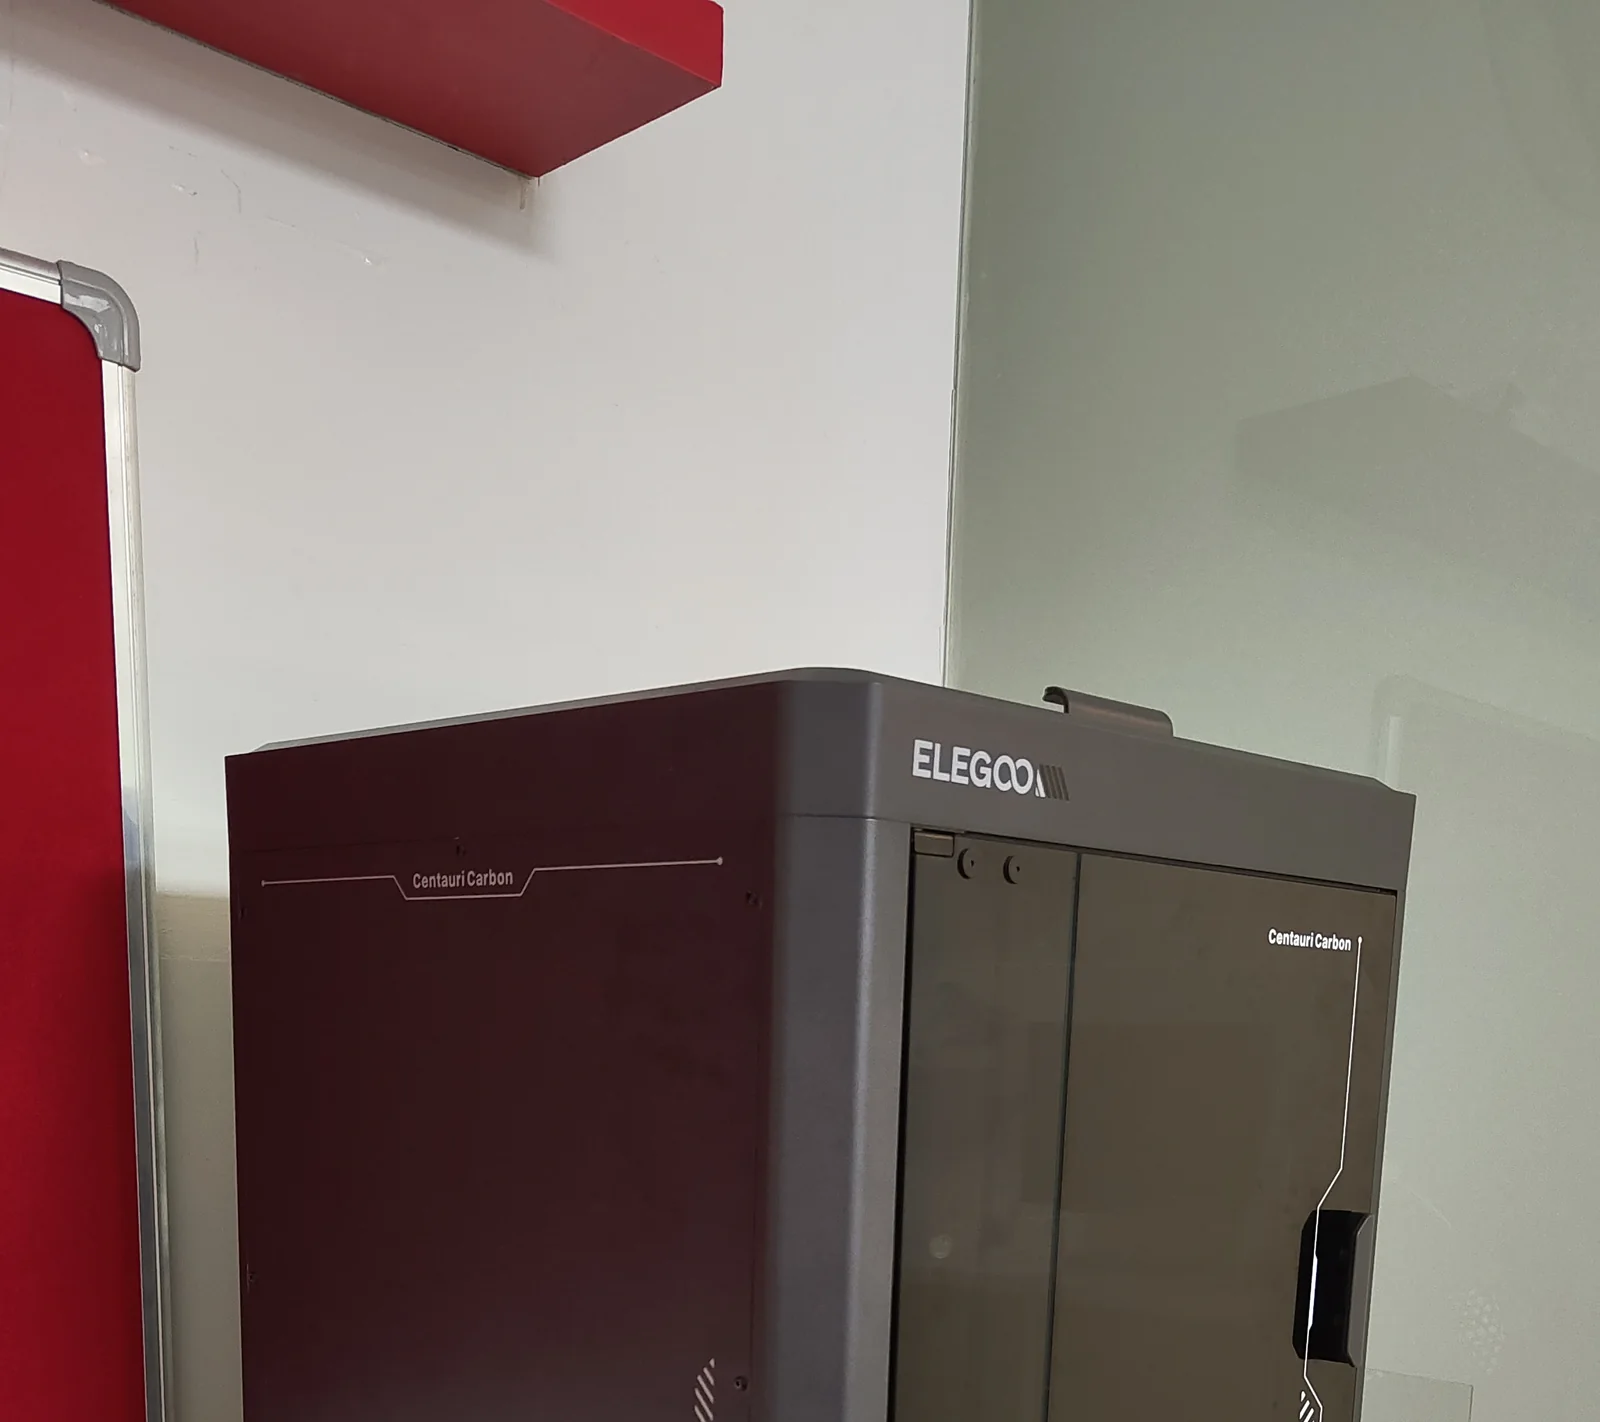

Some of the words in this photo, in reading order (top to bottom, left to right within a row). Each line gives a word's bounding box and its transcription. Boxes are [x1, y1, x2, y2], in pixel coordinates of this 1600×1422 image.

[911, 738, 1034, 795] ELEGOO
[412, 870, 466, 889] Centauri
[466, 868, 513, 887] Carbon
[1268, 928, 1315, 948] Centauri
[1314, 933, 1352, 951] Carbon
